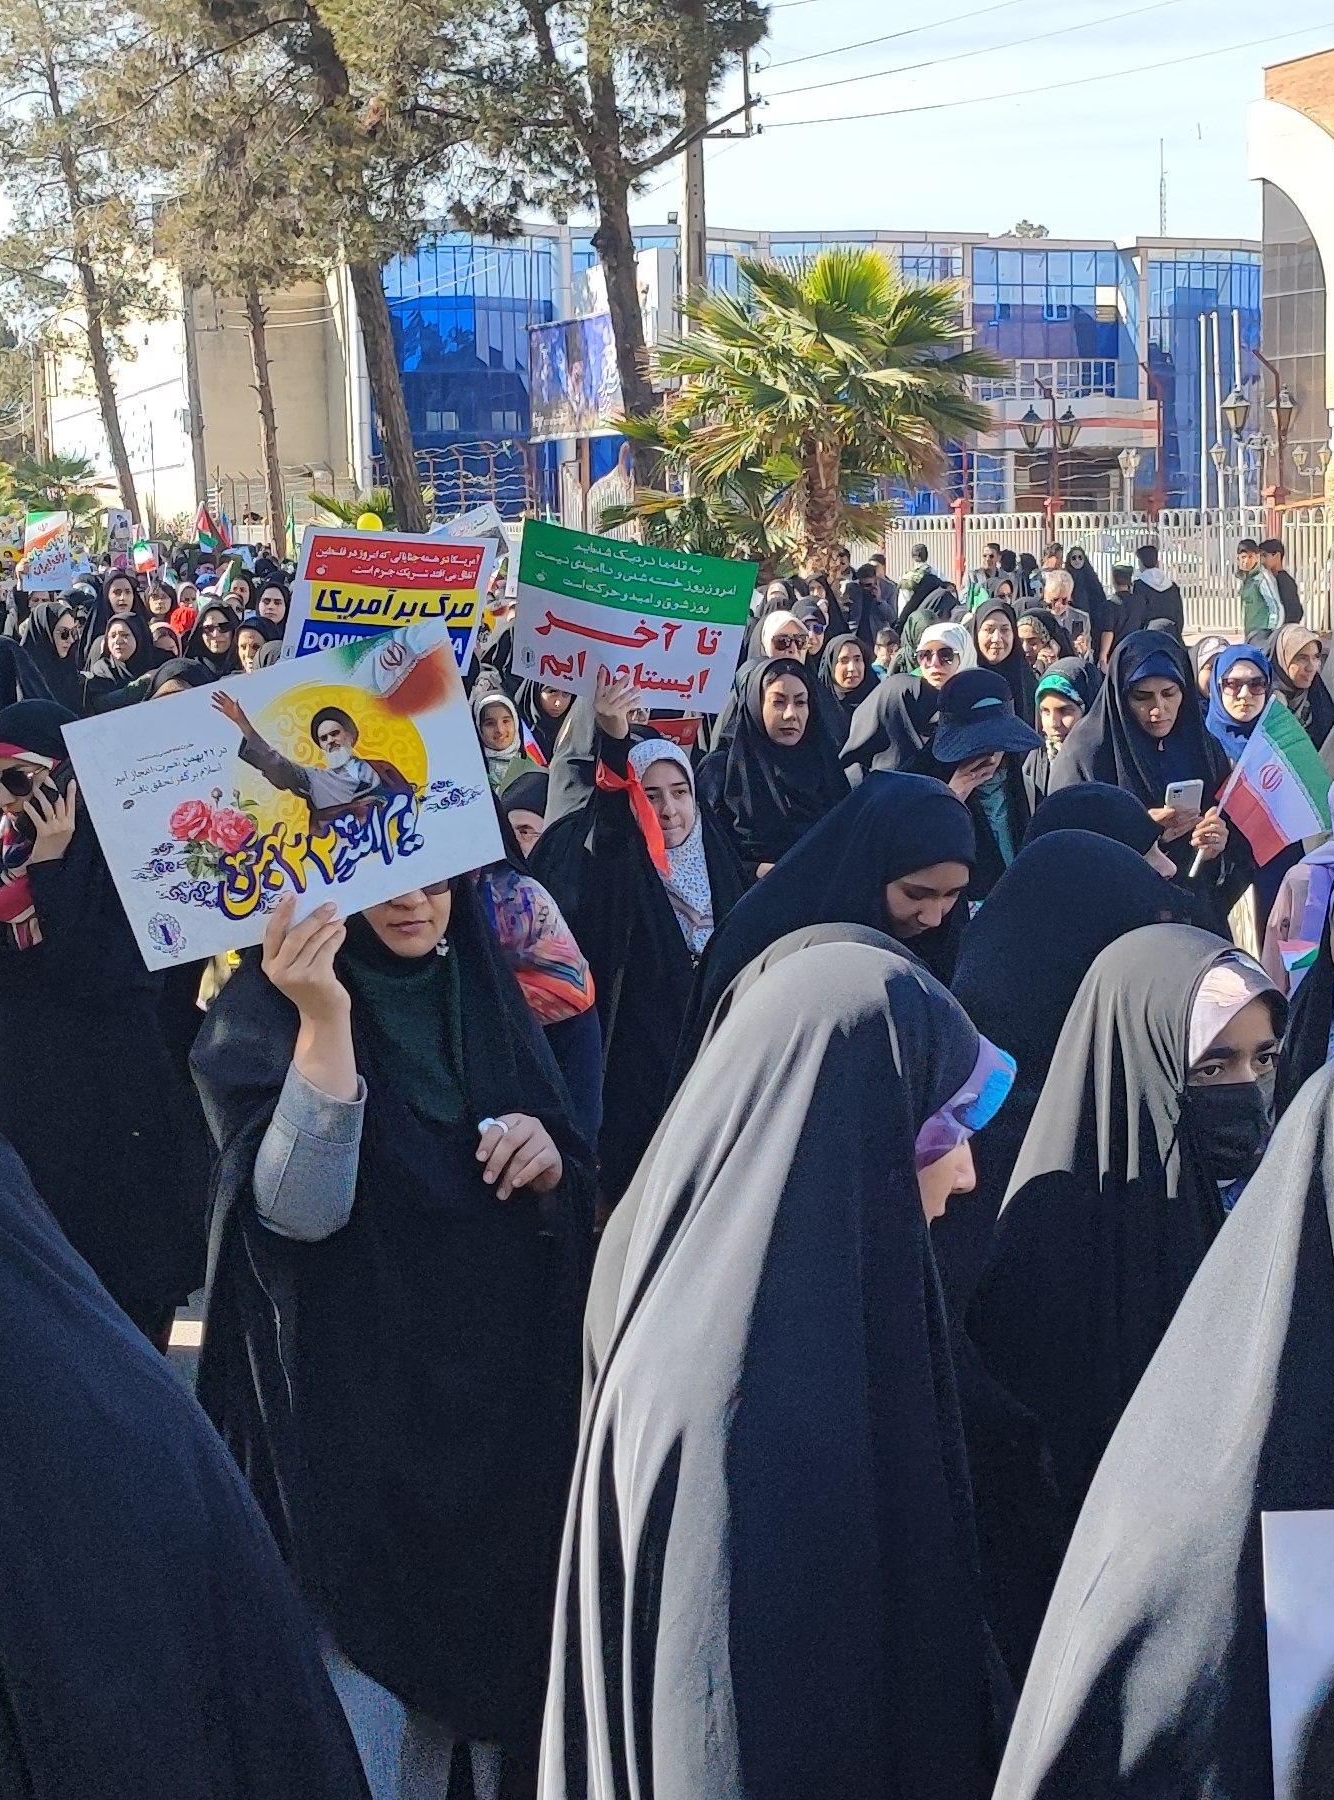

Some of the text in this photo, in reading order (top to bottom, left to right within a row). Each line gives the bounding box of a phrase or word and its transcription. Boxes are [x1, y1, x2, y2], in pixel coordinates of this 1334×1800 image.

[315, 546, 347, 558] فلسطین
[347, 549, 357, 558] در
[356, 548, 379, 562] امروز
[379, 549, 391, 559] که
[613, 549, 655, 568] نزدیک
[351, 565, 374, 575] است
[374, 567, 396, 579] جرم
[535, 550, 737, 598] امروز روز خسته شدن و ناامیدی نیست
[688, 564, 703, 576] به
[562, 578, 710, 614] روز شوق و امید و حرکت است
[315, 588, 475, 623] مرگ بر آمریکا
[534, 610, 723, 656] تا آخر
[539, 650, 587, 681] ایم
[218, 746, 228, 758] در
[182, 753, 205, 768] بهمن
[128, 763, 223, 797] اسلام بر کفر تحقق یافت
[218, 822, 287, 920] بهمن
